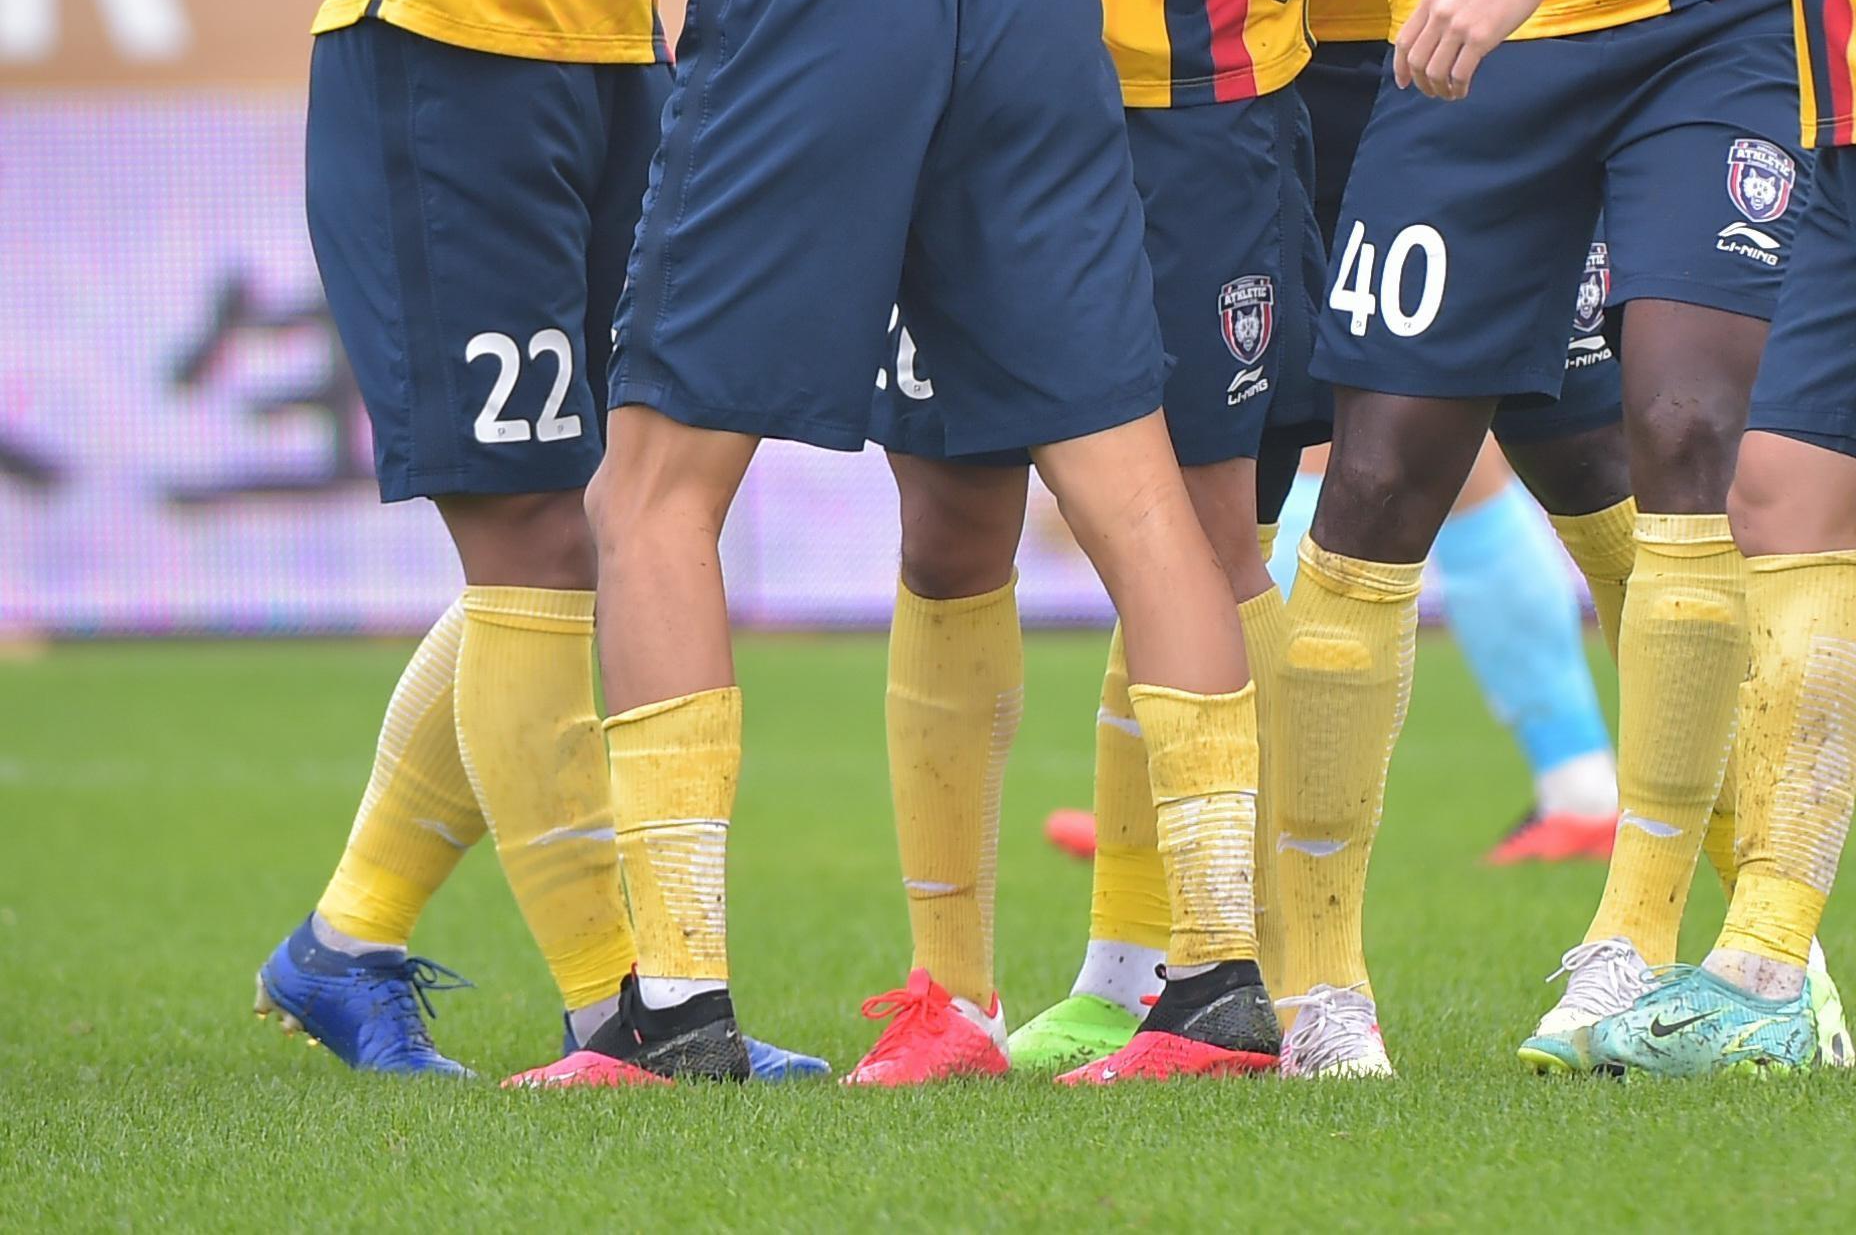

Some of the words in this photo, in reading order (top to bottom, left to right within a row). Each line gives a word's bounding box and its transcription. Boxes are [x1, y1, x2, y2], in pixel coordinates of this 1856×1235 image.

[1330, 220, 1447, 338] 40
[1716, 238, 1779, 266] LI-NING
[466, 329, 583, 444] 22
